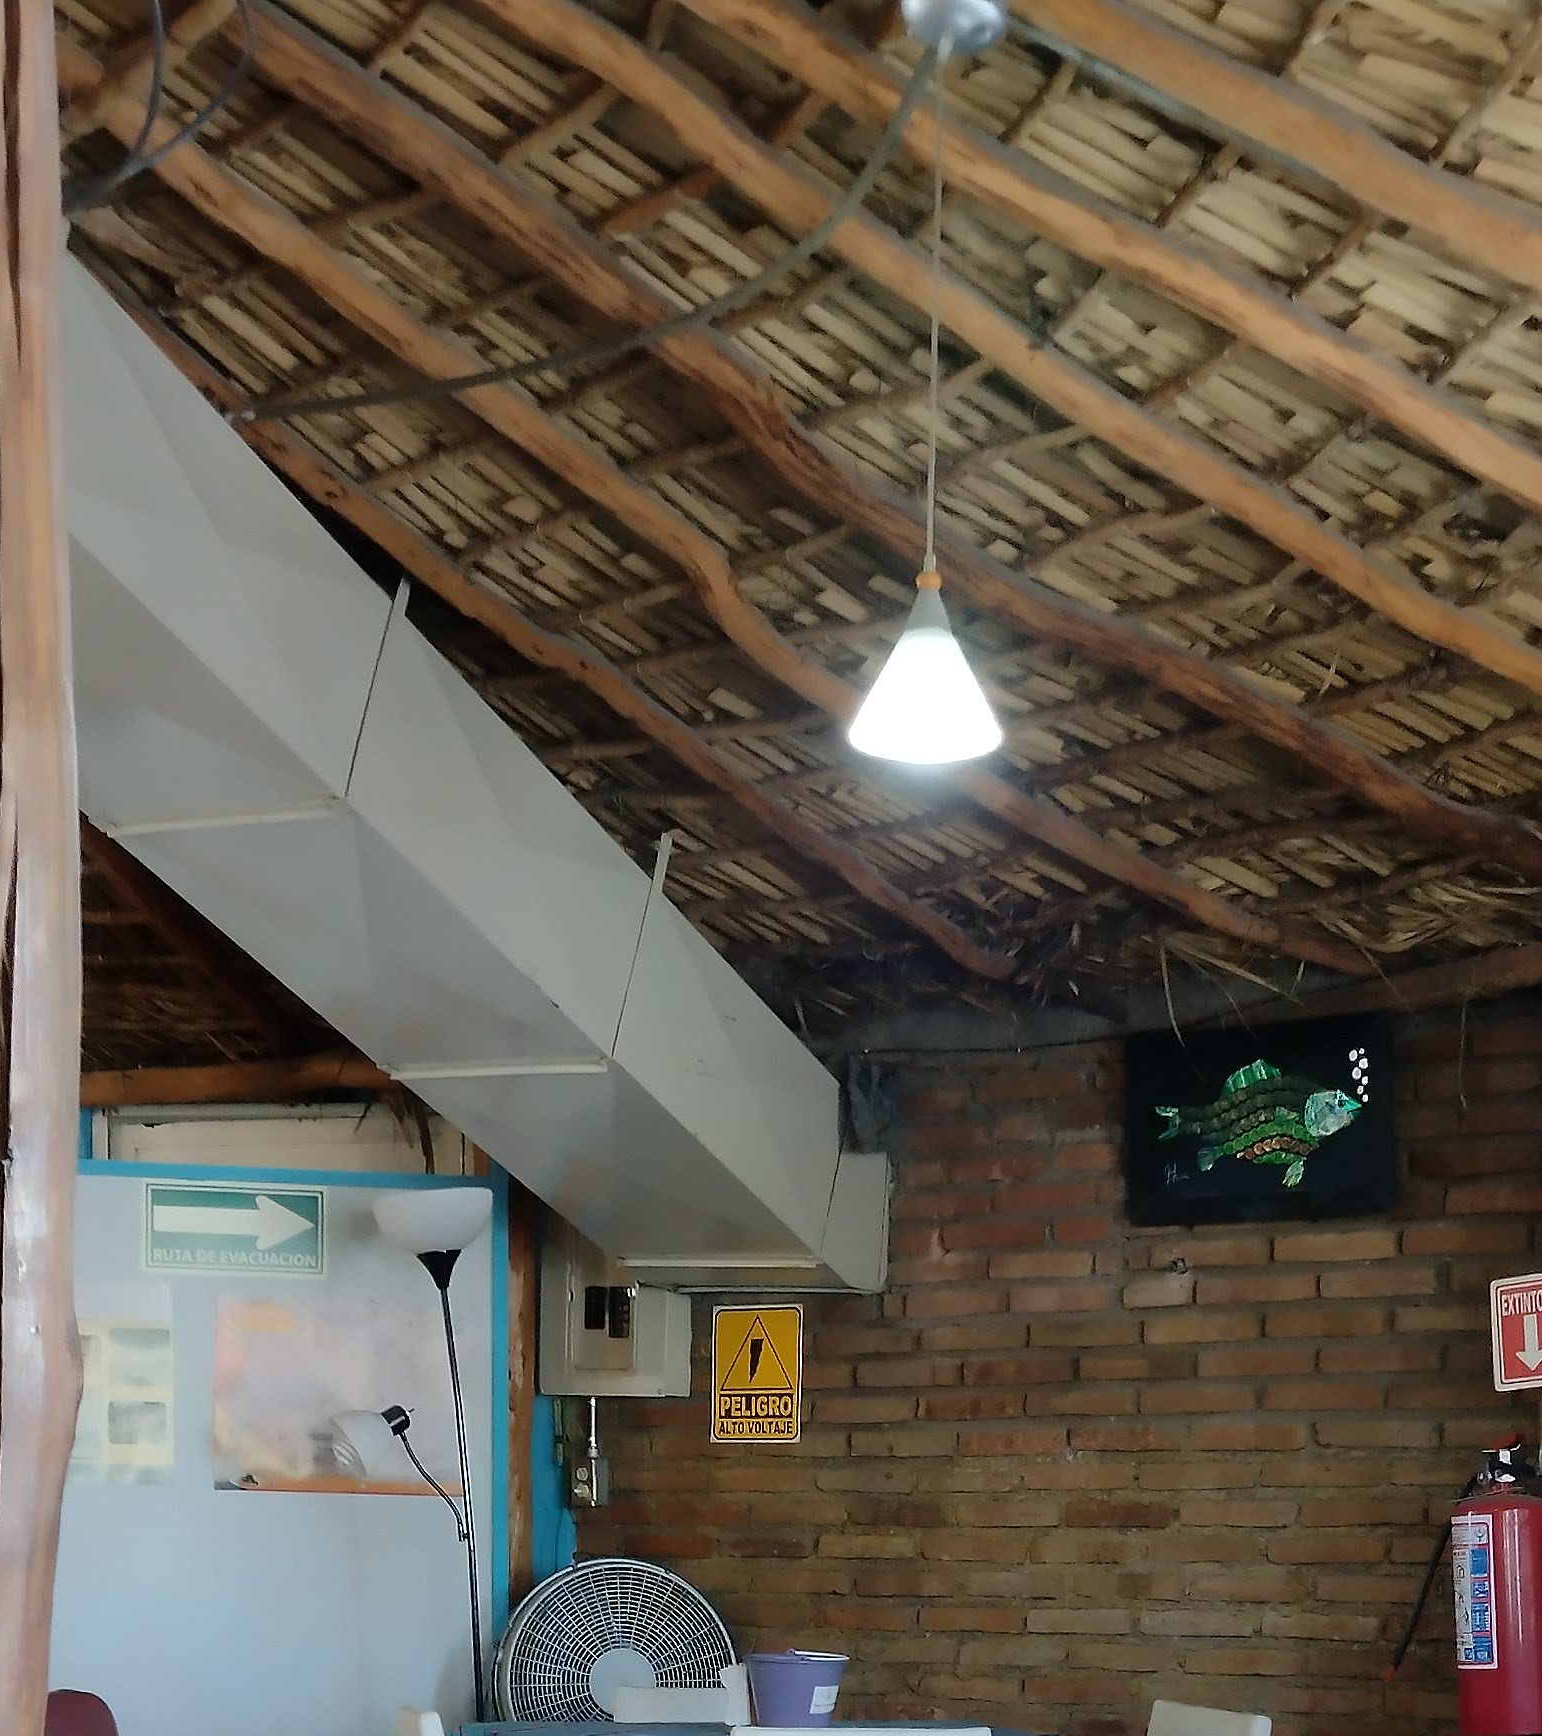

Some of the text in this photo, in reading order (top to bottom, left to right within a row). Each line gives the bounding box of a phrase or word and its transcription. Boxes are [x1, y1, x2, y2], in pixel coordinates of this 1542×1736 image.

[152, 1247, 318, 1268] RUTA DE EVACUACION
[720, 1395, 792, 1417] PELIGRO
[719, 1420, 793, 1435] ALTO VOLTAJE
